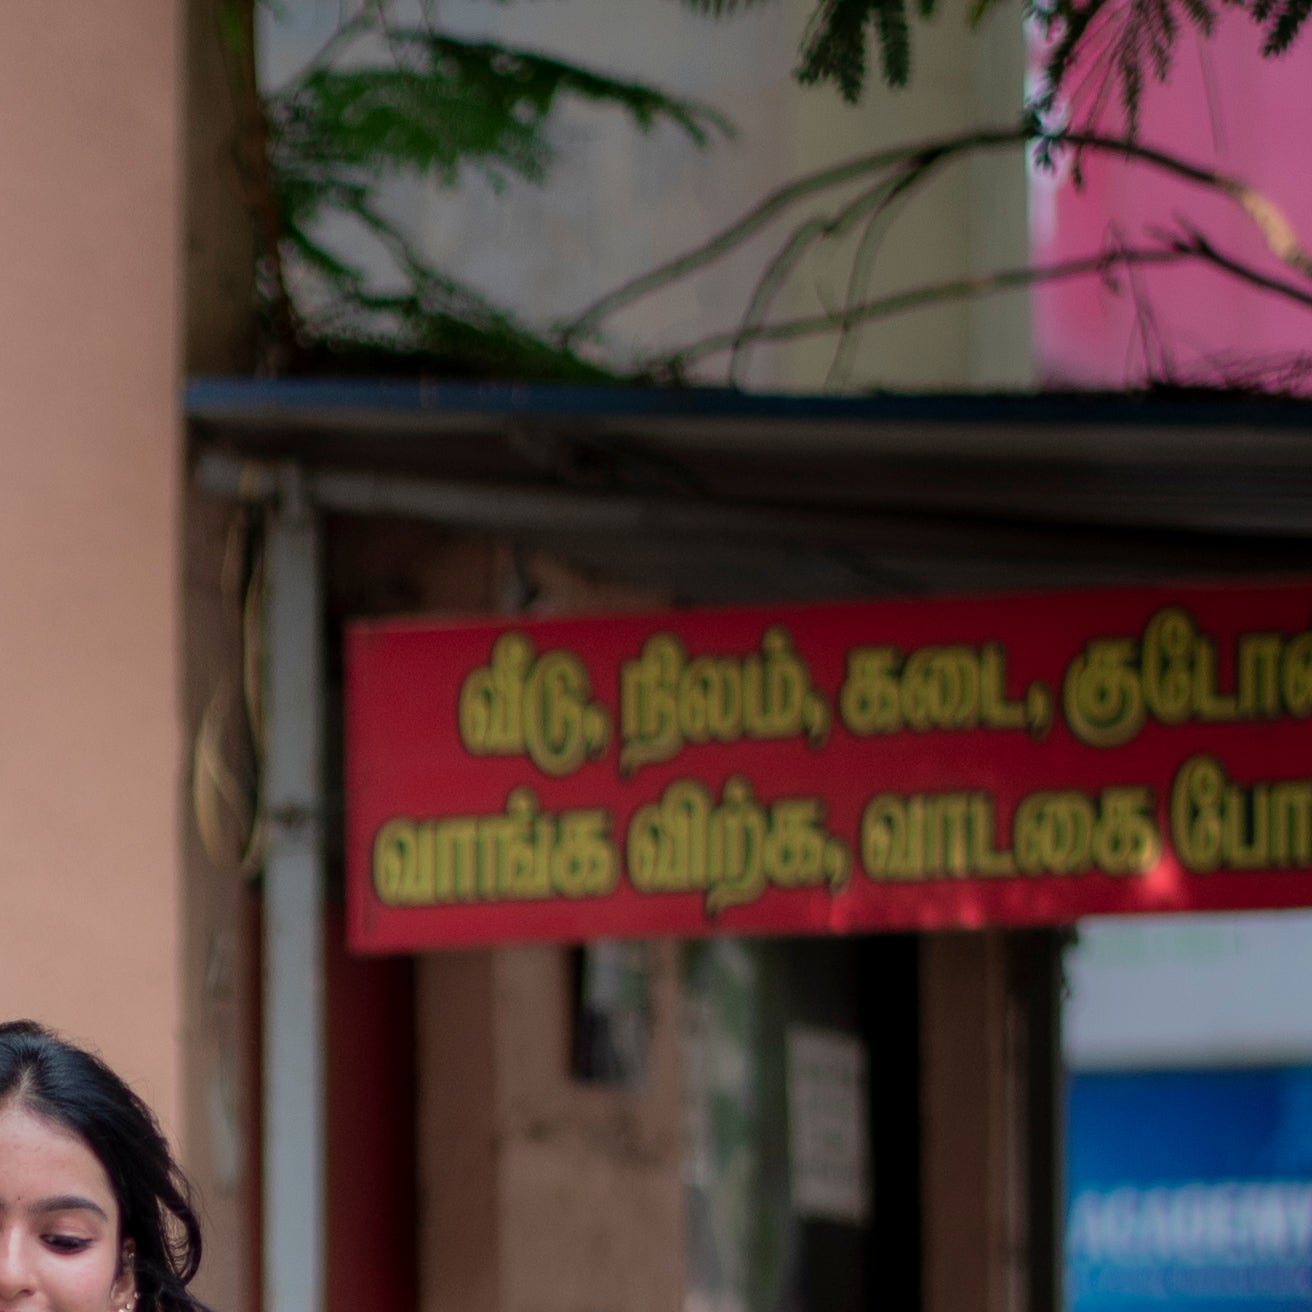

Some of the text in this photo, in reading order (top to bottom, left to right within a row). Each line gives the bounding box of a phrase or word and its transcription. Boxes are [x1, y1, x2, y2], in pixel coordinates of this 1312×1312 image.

[459, 630, 609, 777] வீடு,
[618, 624, 831, 781] நிலம்,
[840, 639, 1053, 741] கடை,
[372, 785, 619, 908] வாங்க
[626, 773, 851, 921] விற்க,
[860, 788, 1161, 883] வாடகை
